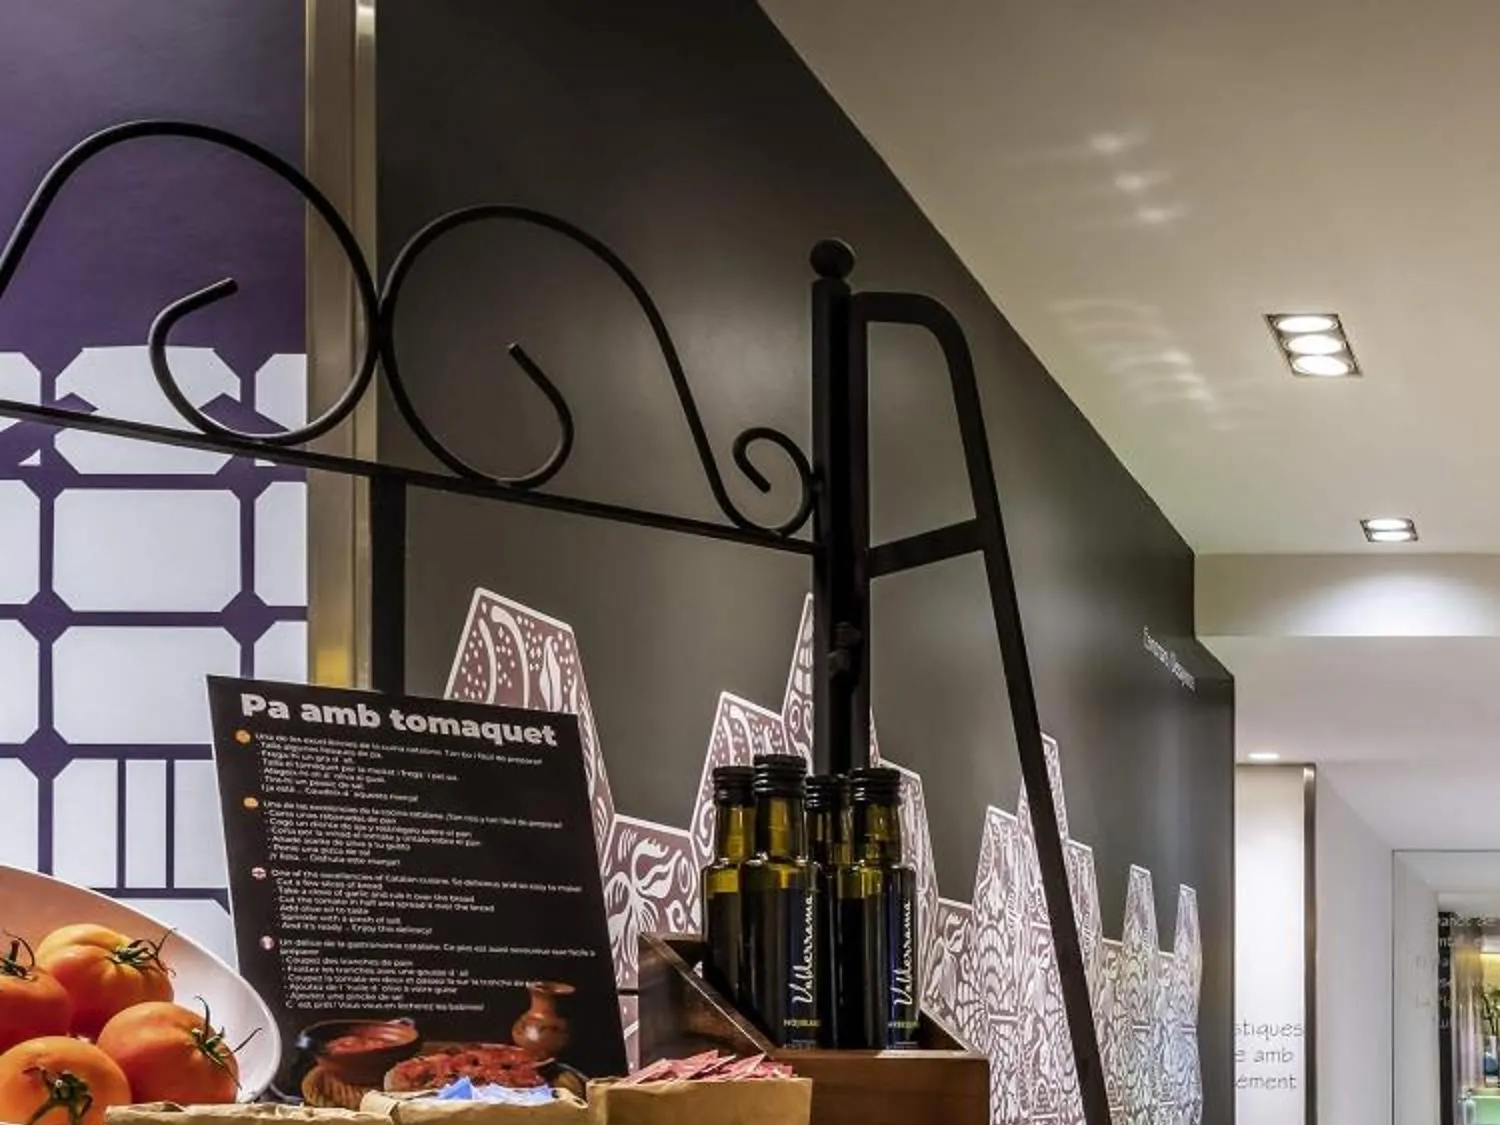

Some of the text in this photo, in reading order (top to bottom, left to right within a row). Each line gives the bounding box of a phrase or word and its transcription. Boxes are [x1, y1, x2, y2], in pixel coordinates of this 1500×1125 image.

[240, 693, 557, 746] Pa amb tomaquet
[1253, 1047, 1294, 1063] amb
